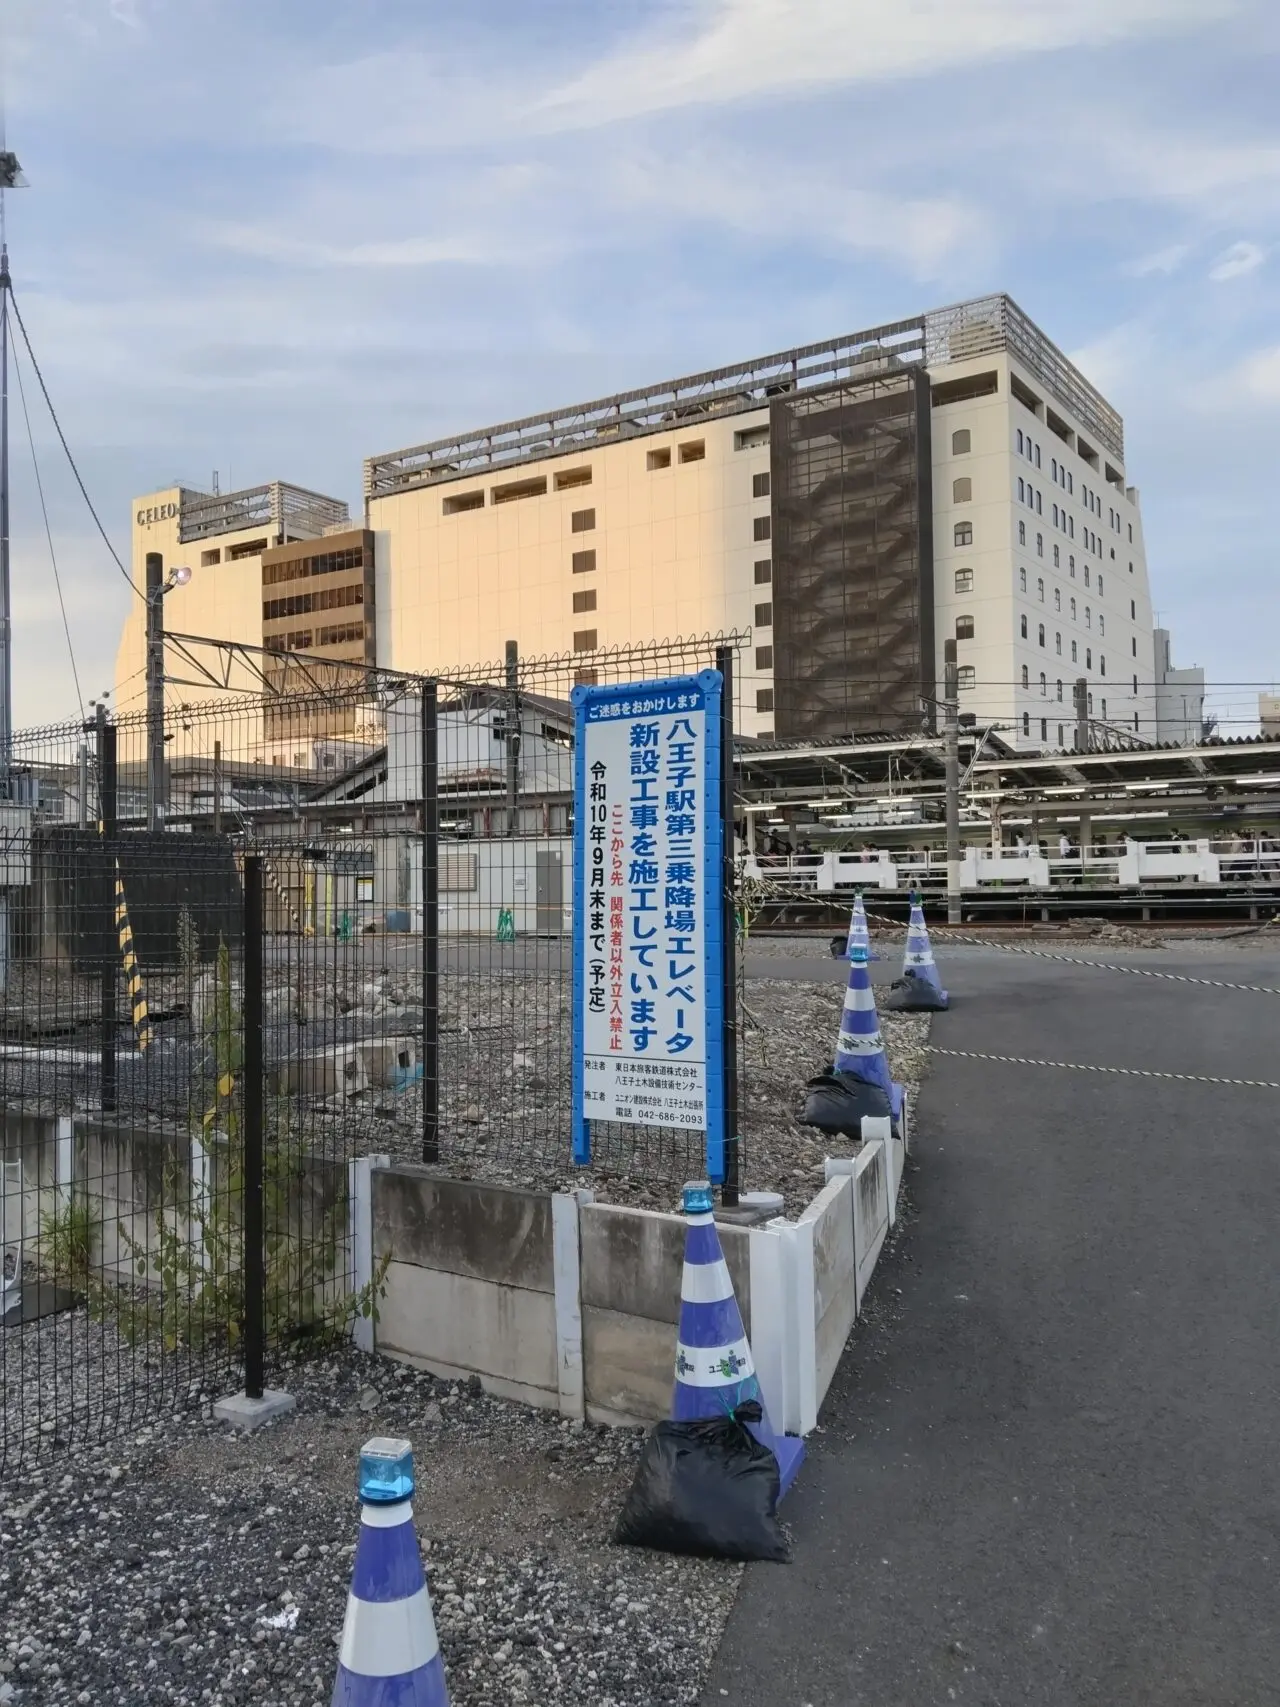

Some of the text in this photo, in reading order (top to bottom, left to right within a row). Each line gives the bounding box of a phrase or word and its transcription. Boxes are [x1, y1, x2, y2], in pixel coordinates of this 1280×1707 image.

[589, 692, 701, 719] ご迷惑をおかけします
[628, 720, 661, 1052] 新設工事を施工しています
[664, 718, 698, 1054] 八王子駅第三乗降場エレベータ
[609, 804, 625, 1051] ここから先 関係者以外立入禁止
[584, 1059, 698, 1078] 発注者 東日本旅客鉄道株式会社
[584, 1089, 606, 1102] 施工者
[615, 1076, 703, 1092] 八王子土木設備技術センター
[615, 1107, 703, 1124] 電話 042-686-2093
